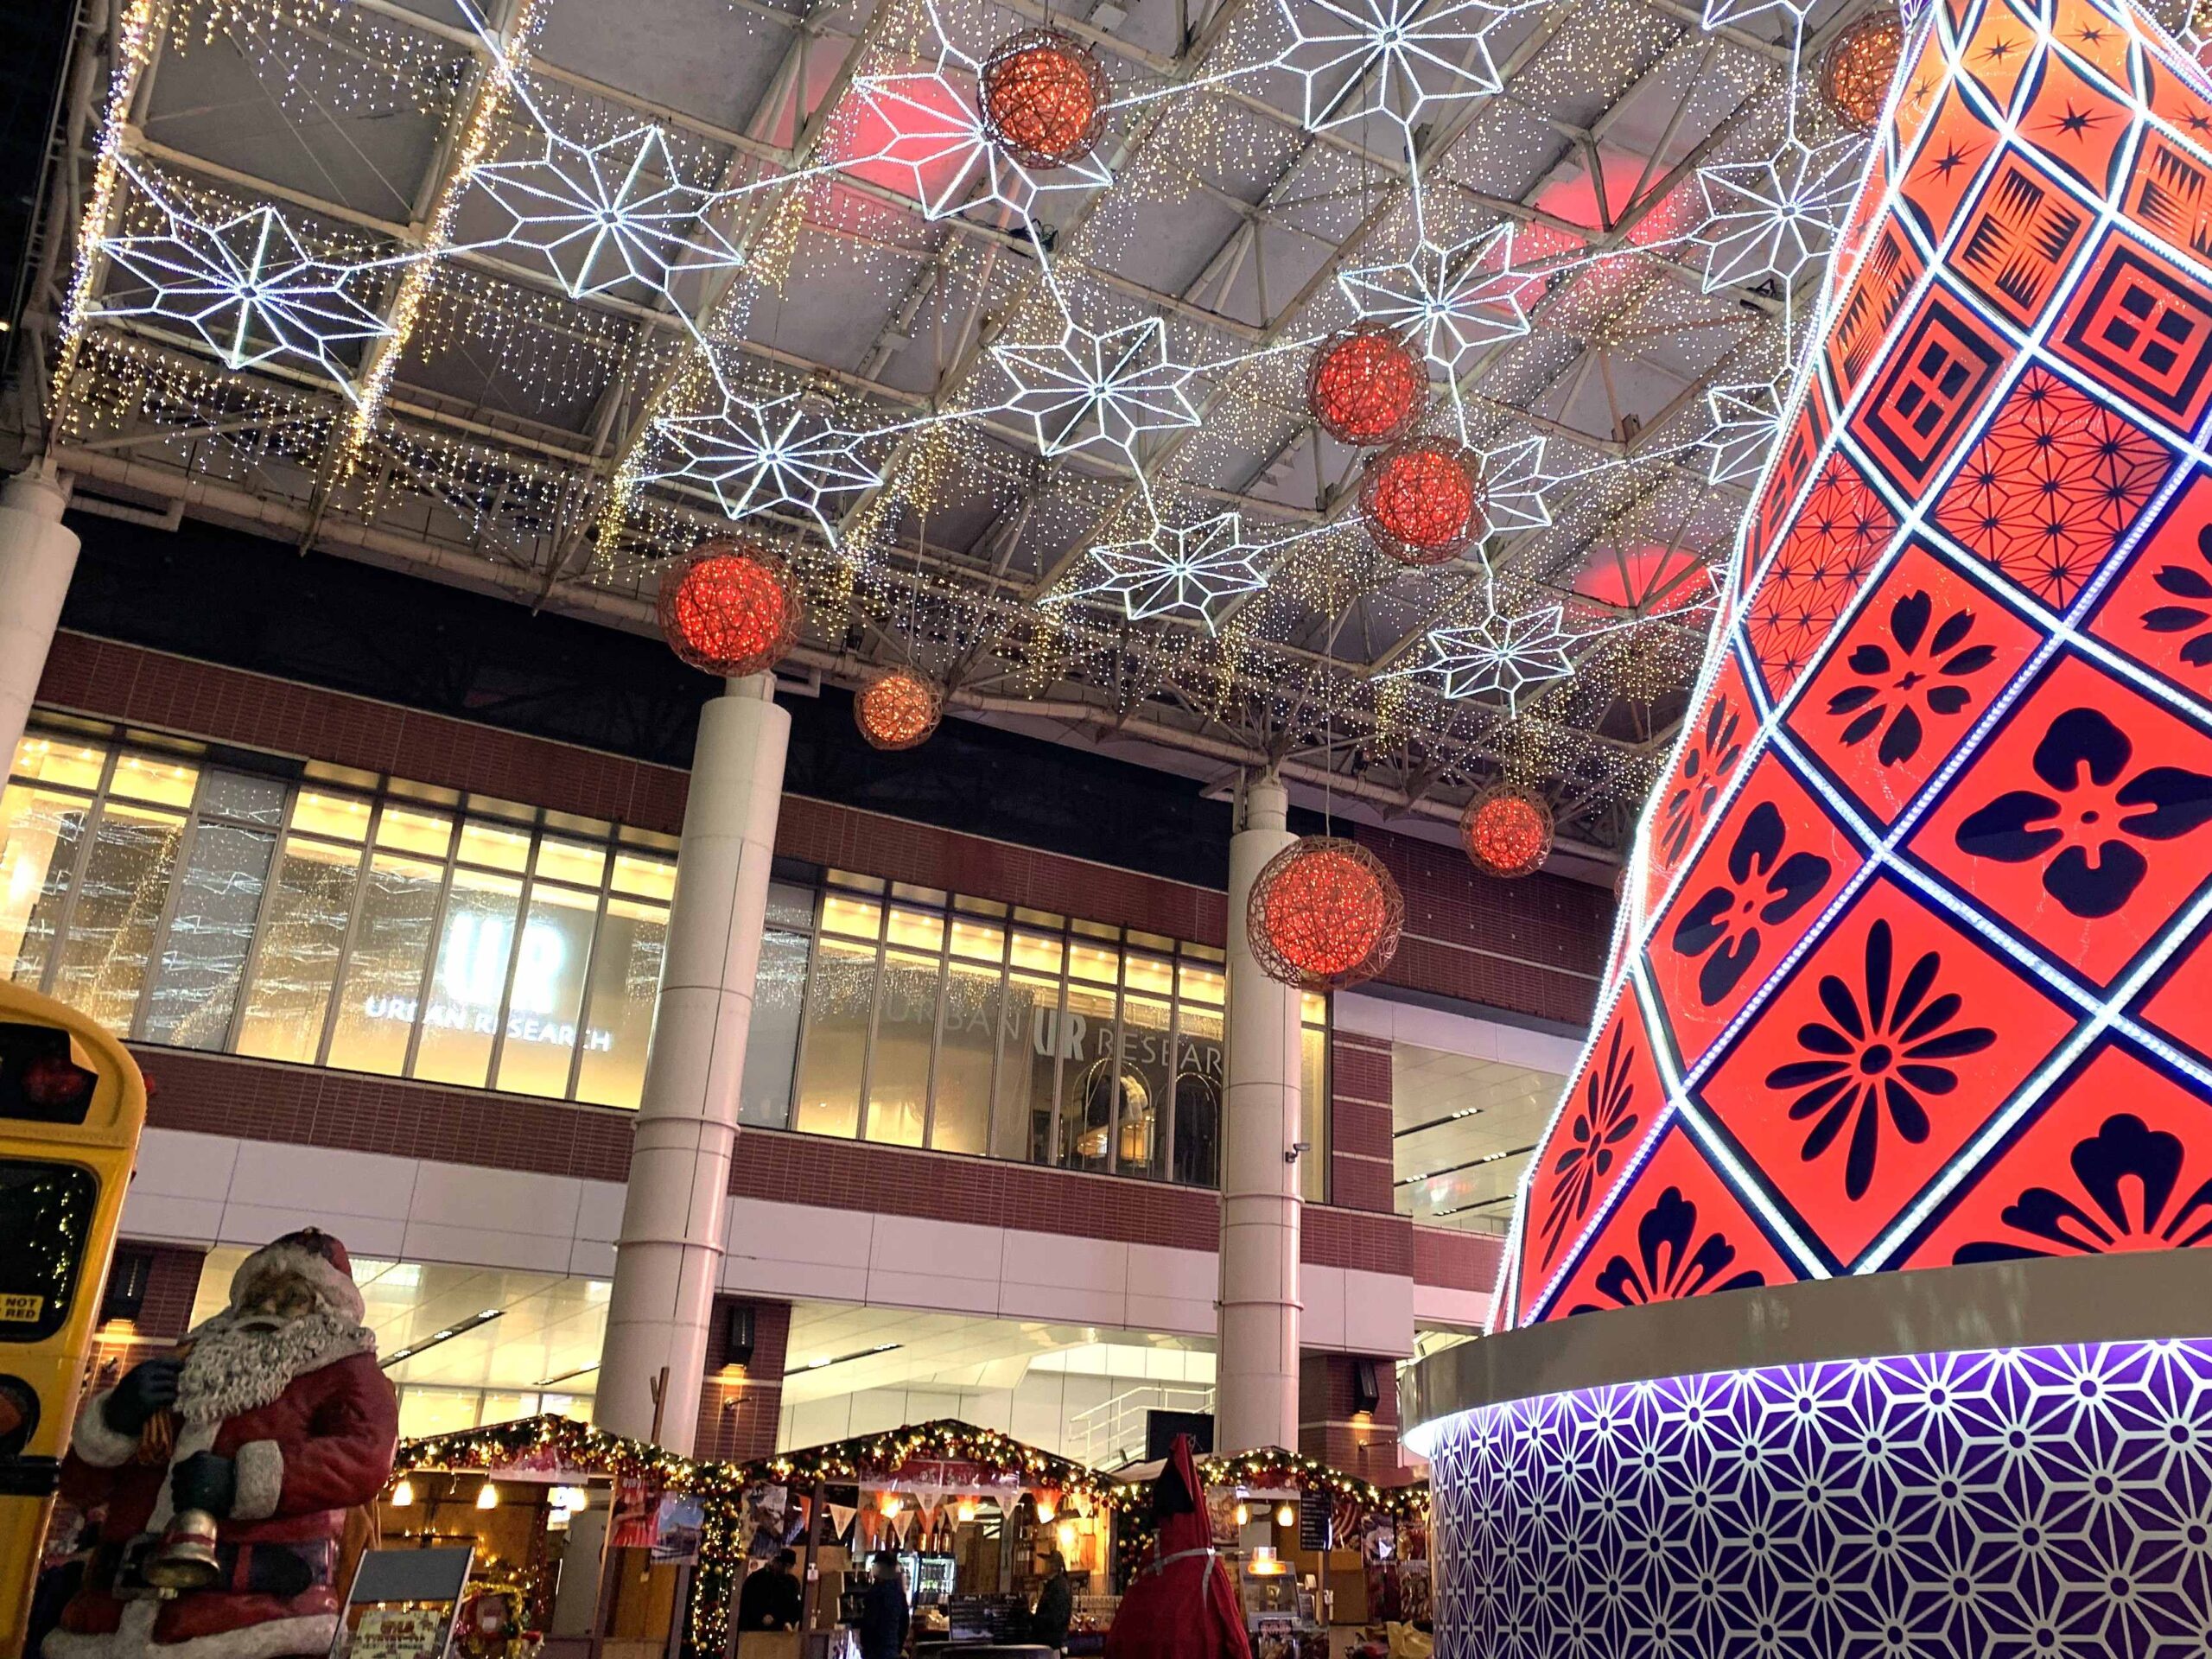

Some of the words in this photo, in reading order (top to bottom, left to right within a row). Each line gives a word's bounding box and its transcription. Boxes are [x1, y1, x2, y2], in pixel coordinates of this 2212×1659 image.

[444, 912, 565, 1014] UR
[474, 1013, 613, 1052] RSEARH
[887, 991, 1020, 1040] URBAN
[1033, 1007, 1087, 1061] UR
[1098, 1027, 1223, 1075] RESEAR
[5, 1308, 35, 1318] RED
[6, 1298, 37, 1307] NOT
